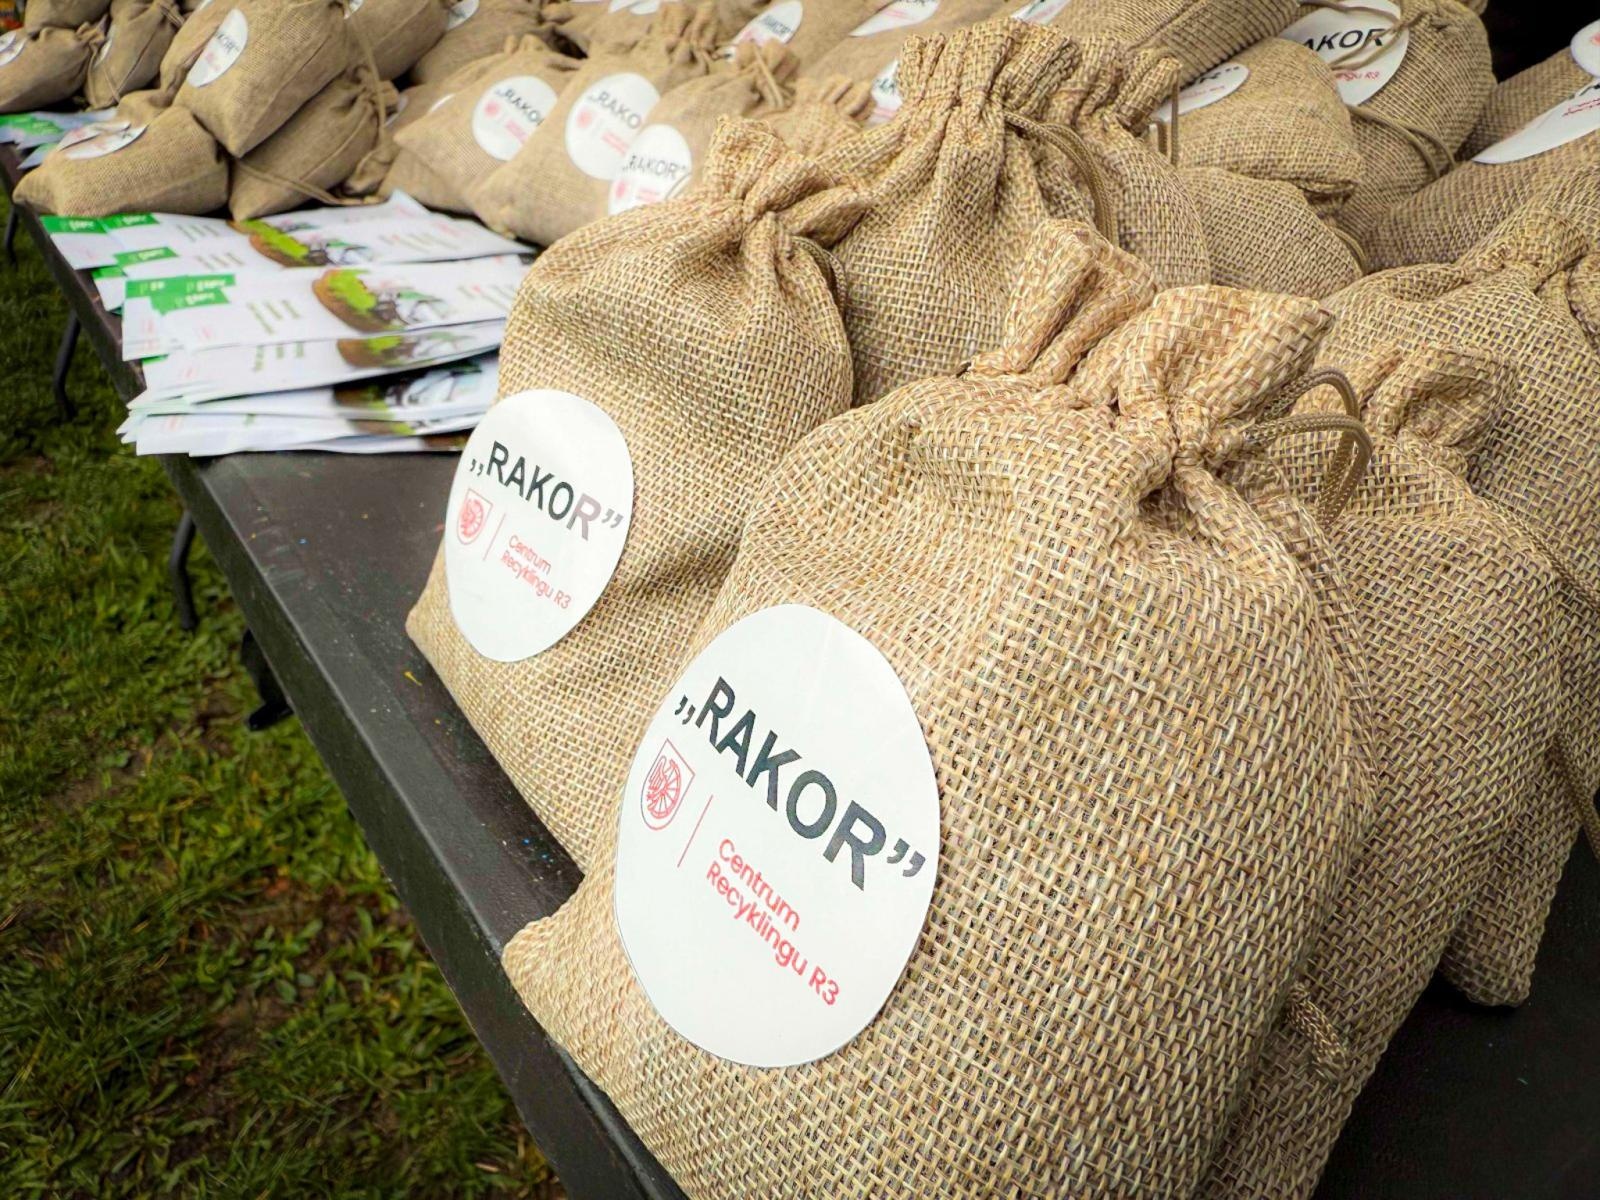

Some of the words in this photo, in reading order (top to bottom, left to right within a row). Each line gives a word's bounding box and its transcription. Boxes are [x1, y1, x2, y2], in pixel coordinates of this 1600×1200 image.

[500, 551, 556, 599] Recyklingu
[553, 589, 573, 611] R3
[508, 534, 553, 575] Centrum
[718, 838, 800, 932] Centrum
[705, 860, 808, 977] Recyklingu
[808, 964, 841, 1007] R3
